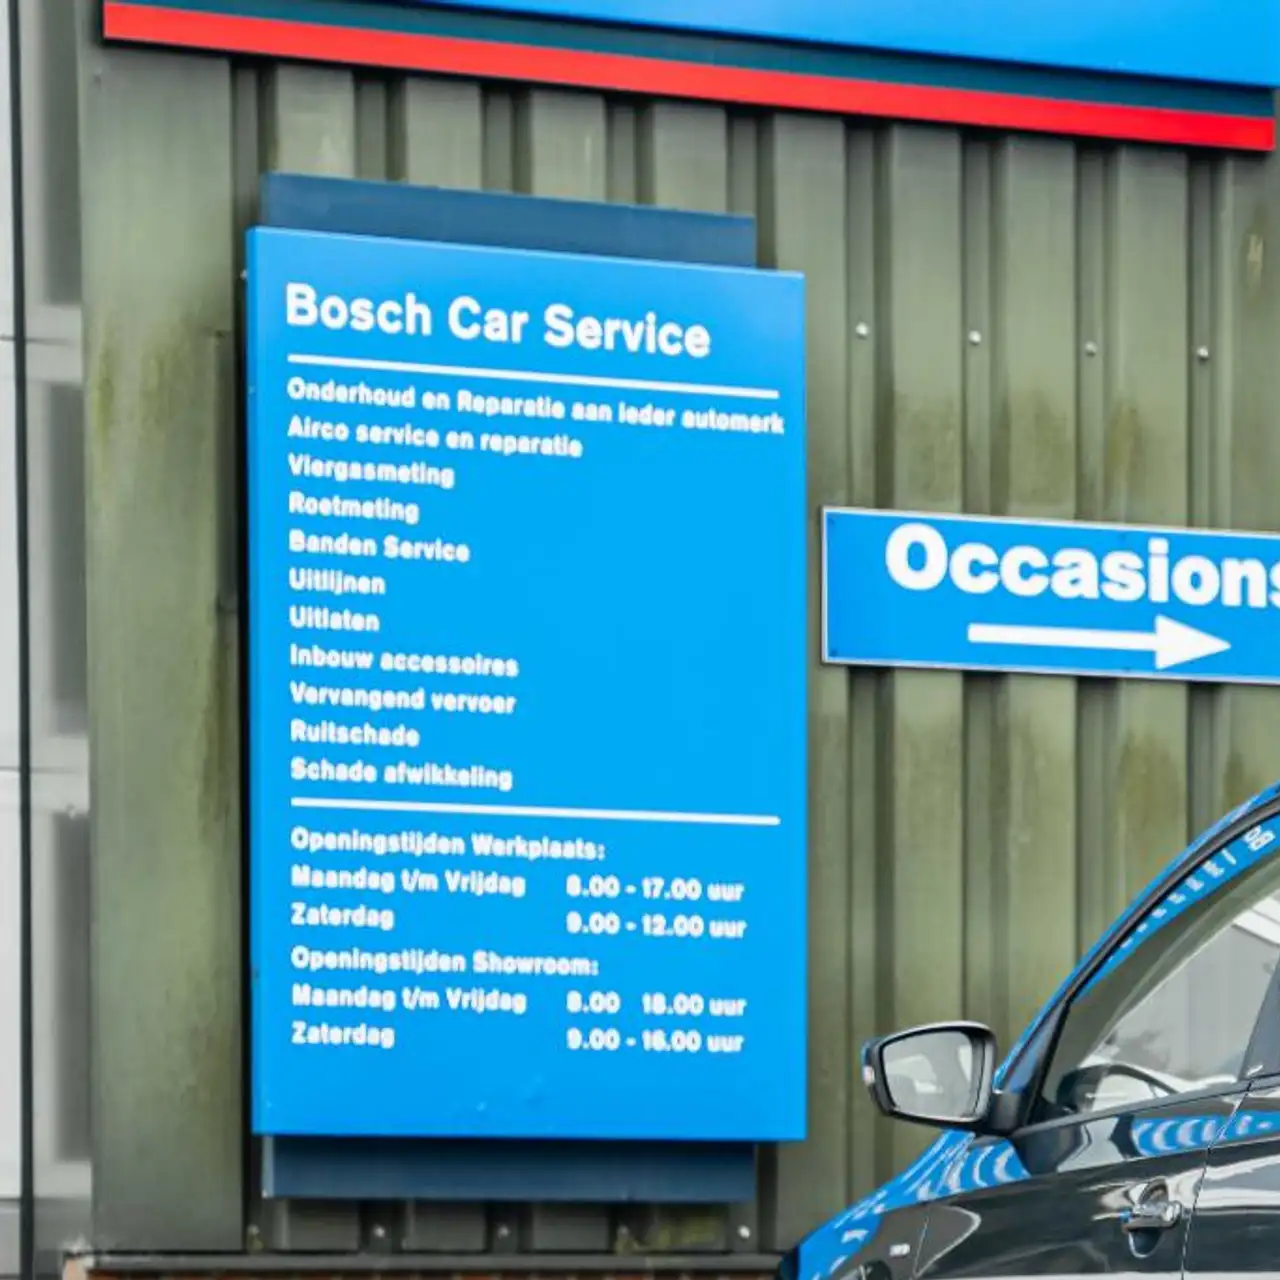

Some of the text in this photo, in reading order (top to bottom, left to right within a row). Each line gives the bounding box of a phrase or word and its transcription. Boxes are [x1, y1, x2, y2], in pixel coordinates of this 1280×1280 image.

[285, 281, 711, 358] Bosch Car Service
[287, 376, 785, 434] Onderhoud en Reparatie aan ieder automerk
[287, 415, 583, 458] Airco service en reparatie
[288, 452, 455, 489] Viergasmeting
[288, 490, 420, 525] Roetmeting
[288, 528, 470, 563] Banden Service
[288, 567, 386, 595] Uitlijnen
[289, 605, 380, 632] Uitlaten
[290, 643, 519, 677] Inbouw accessoires
[289, 681, 517, 714] Vervangend vervoer
[290, 718, 420, 747] Ruitschade
[290, 756, 513, 792] Schade afwikkeling
[290, 826, 605, 861] Openingstijden Werkplaats:
[291, 864, 396, 894] Maandag
[400, 869, 439, 893] t/m
[444, 870, 526, 898] Vrijdag
[641, 876, 702, 901] 17.00
[707, 883, 745, 902] uur
[291, 901, 395, 931] Zaterdag
[642, 914, 705, 938] 12.00
[709, 920, 747, 938] uur
[291, 945, 599, 976] Openingstijden Showroom:
[292, 983, 396, 1011] Maandag
[401, 987, 440, 1010] t/m
[446, 987, 527, 1014] Vrijdag
[709, 999, 746, 1016] uur
[292, 1020, 395, 1049] Zaterdag
[706, 1035, 744, 1053] uur
